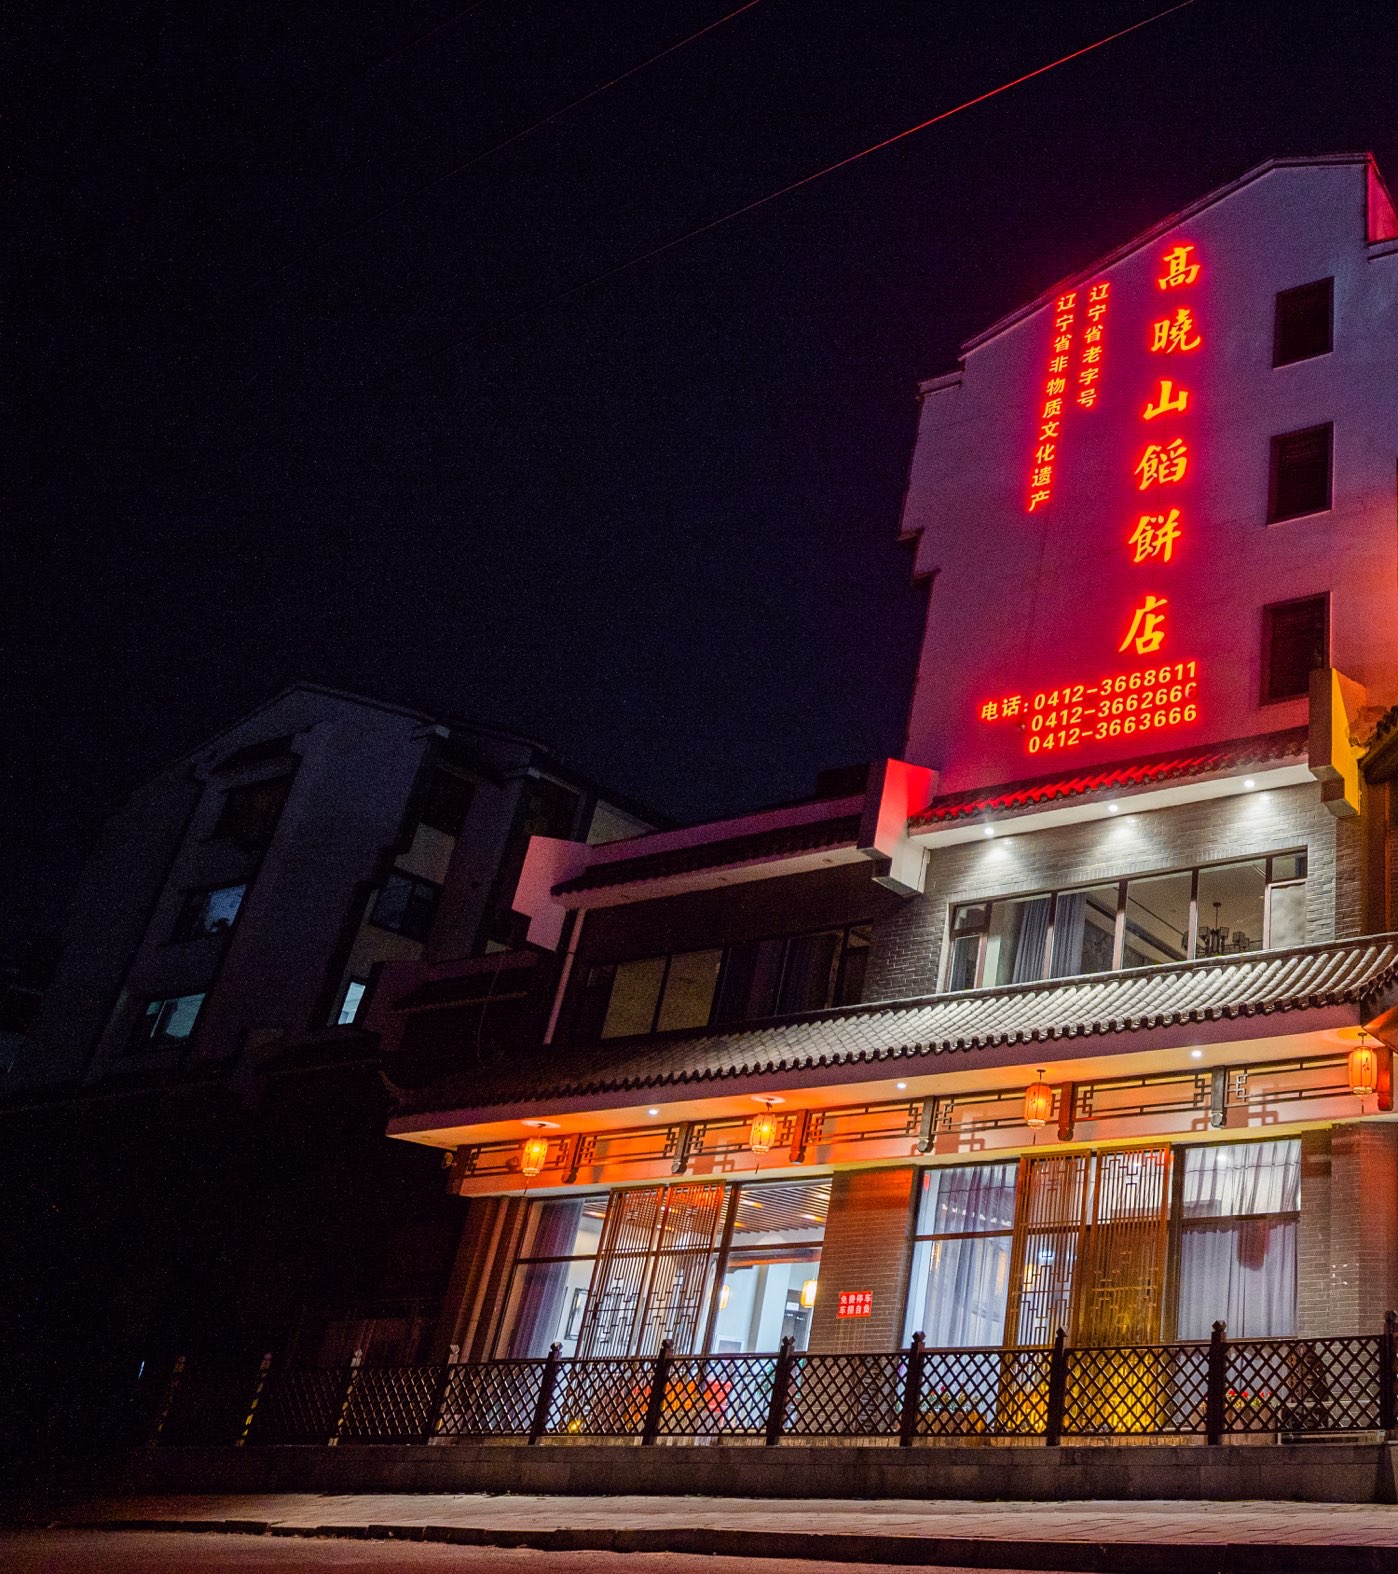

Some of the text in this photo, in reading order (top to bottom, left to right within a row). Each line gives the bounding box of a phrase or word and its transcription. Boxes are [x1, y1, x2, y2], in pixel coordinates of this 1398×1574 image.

[1077, 283, 1110, 407] 辽宁省老字号
[1028, 292, 1078, 513] 辽宁省非物质文化遗产
[1028, 704, 1198, 754] 0412-3663666
[1031, 682, 1198, 732] 0412-3662666
[839, 1304, 870, 1315] 车损自负
[840, 1294, 872, 1304] 免费停车
